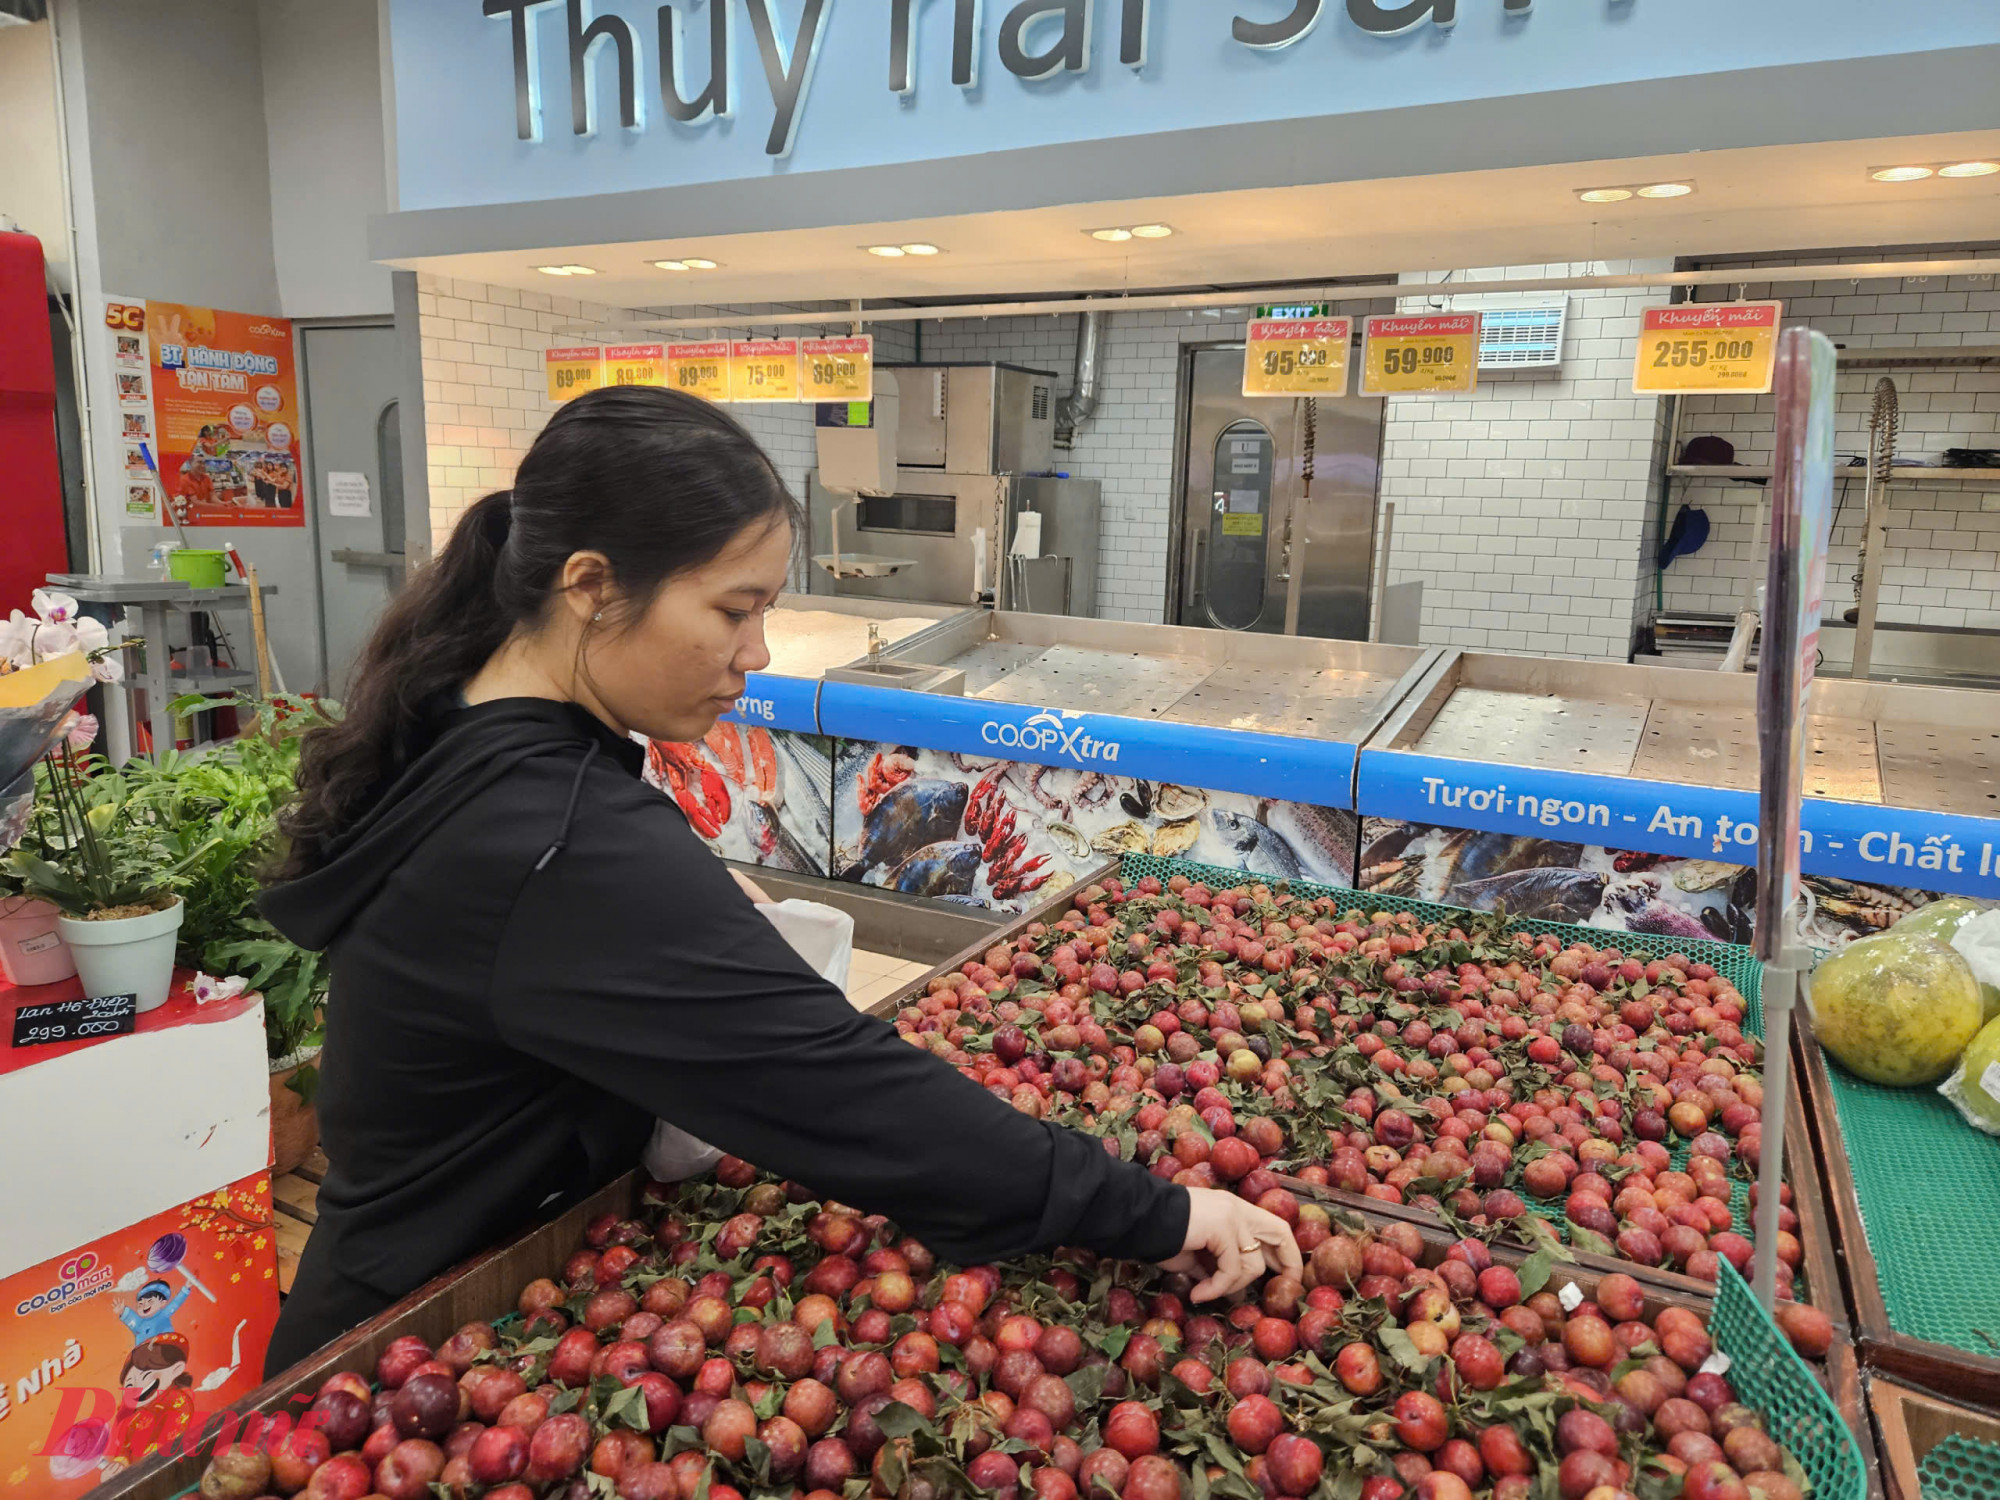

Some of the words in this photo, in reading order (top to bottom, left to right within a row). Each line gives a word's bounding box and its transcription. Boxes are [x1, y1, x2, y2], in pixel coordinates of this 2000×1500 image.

[105, 303, 145, 331] 5C
[1272, 307, 1313, 319] EXIT
[1659, 308, 1725, 326] Khuyến
[1728, 309, 1763, 321] mãi
[1381, 318, 1436, 334] Khuyến
[1439, 318, 1469, 329] mãi
[161, 345, 183, 365] 3T
[188, 346, 231, 368] HÀNH
[232, 353, 277, 376] ĐỘNG
[1264, 350, 1326, 375] 95.000
[1384, 346, 1453, 374] 59.900
[1653, 341, 1753, 367] 255.000
[178, 369, 211, 392] TẬN
[212, 370, 247, 393] TÂM
[556, 368, 591, 388] 69.000
[679, 366, 718, 386] 89.000
[747, 364, 784, 385] 75.000
[1422, 777, 1508, 813] Tươi
[1517, 794, 1610, 826] ngon
[1647, 805, 1703, 838] An
[1716, 814, 1813, 853] ton
[1858, 831, 1966, 873] Chất
[17, 1007, 53, 1019] Lan
[19, 1021, 119, 1043] 299.000
